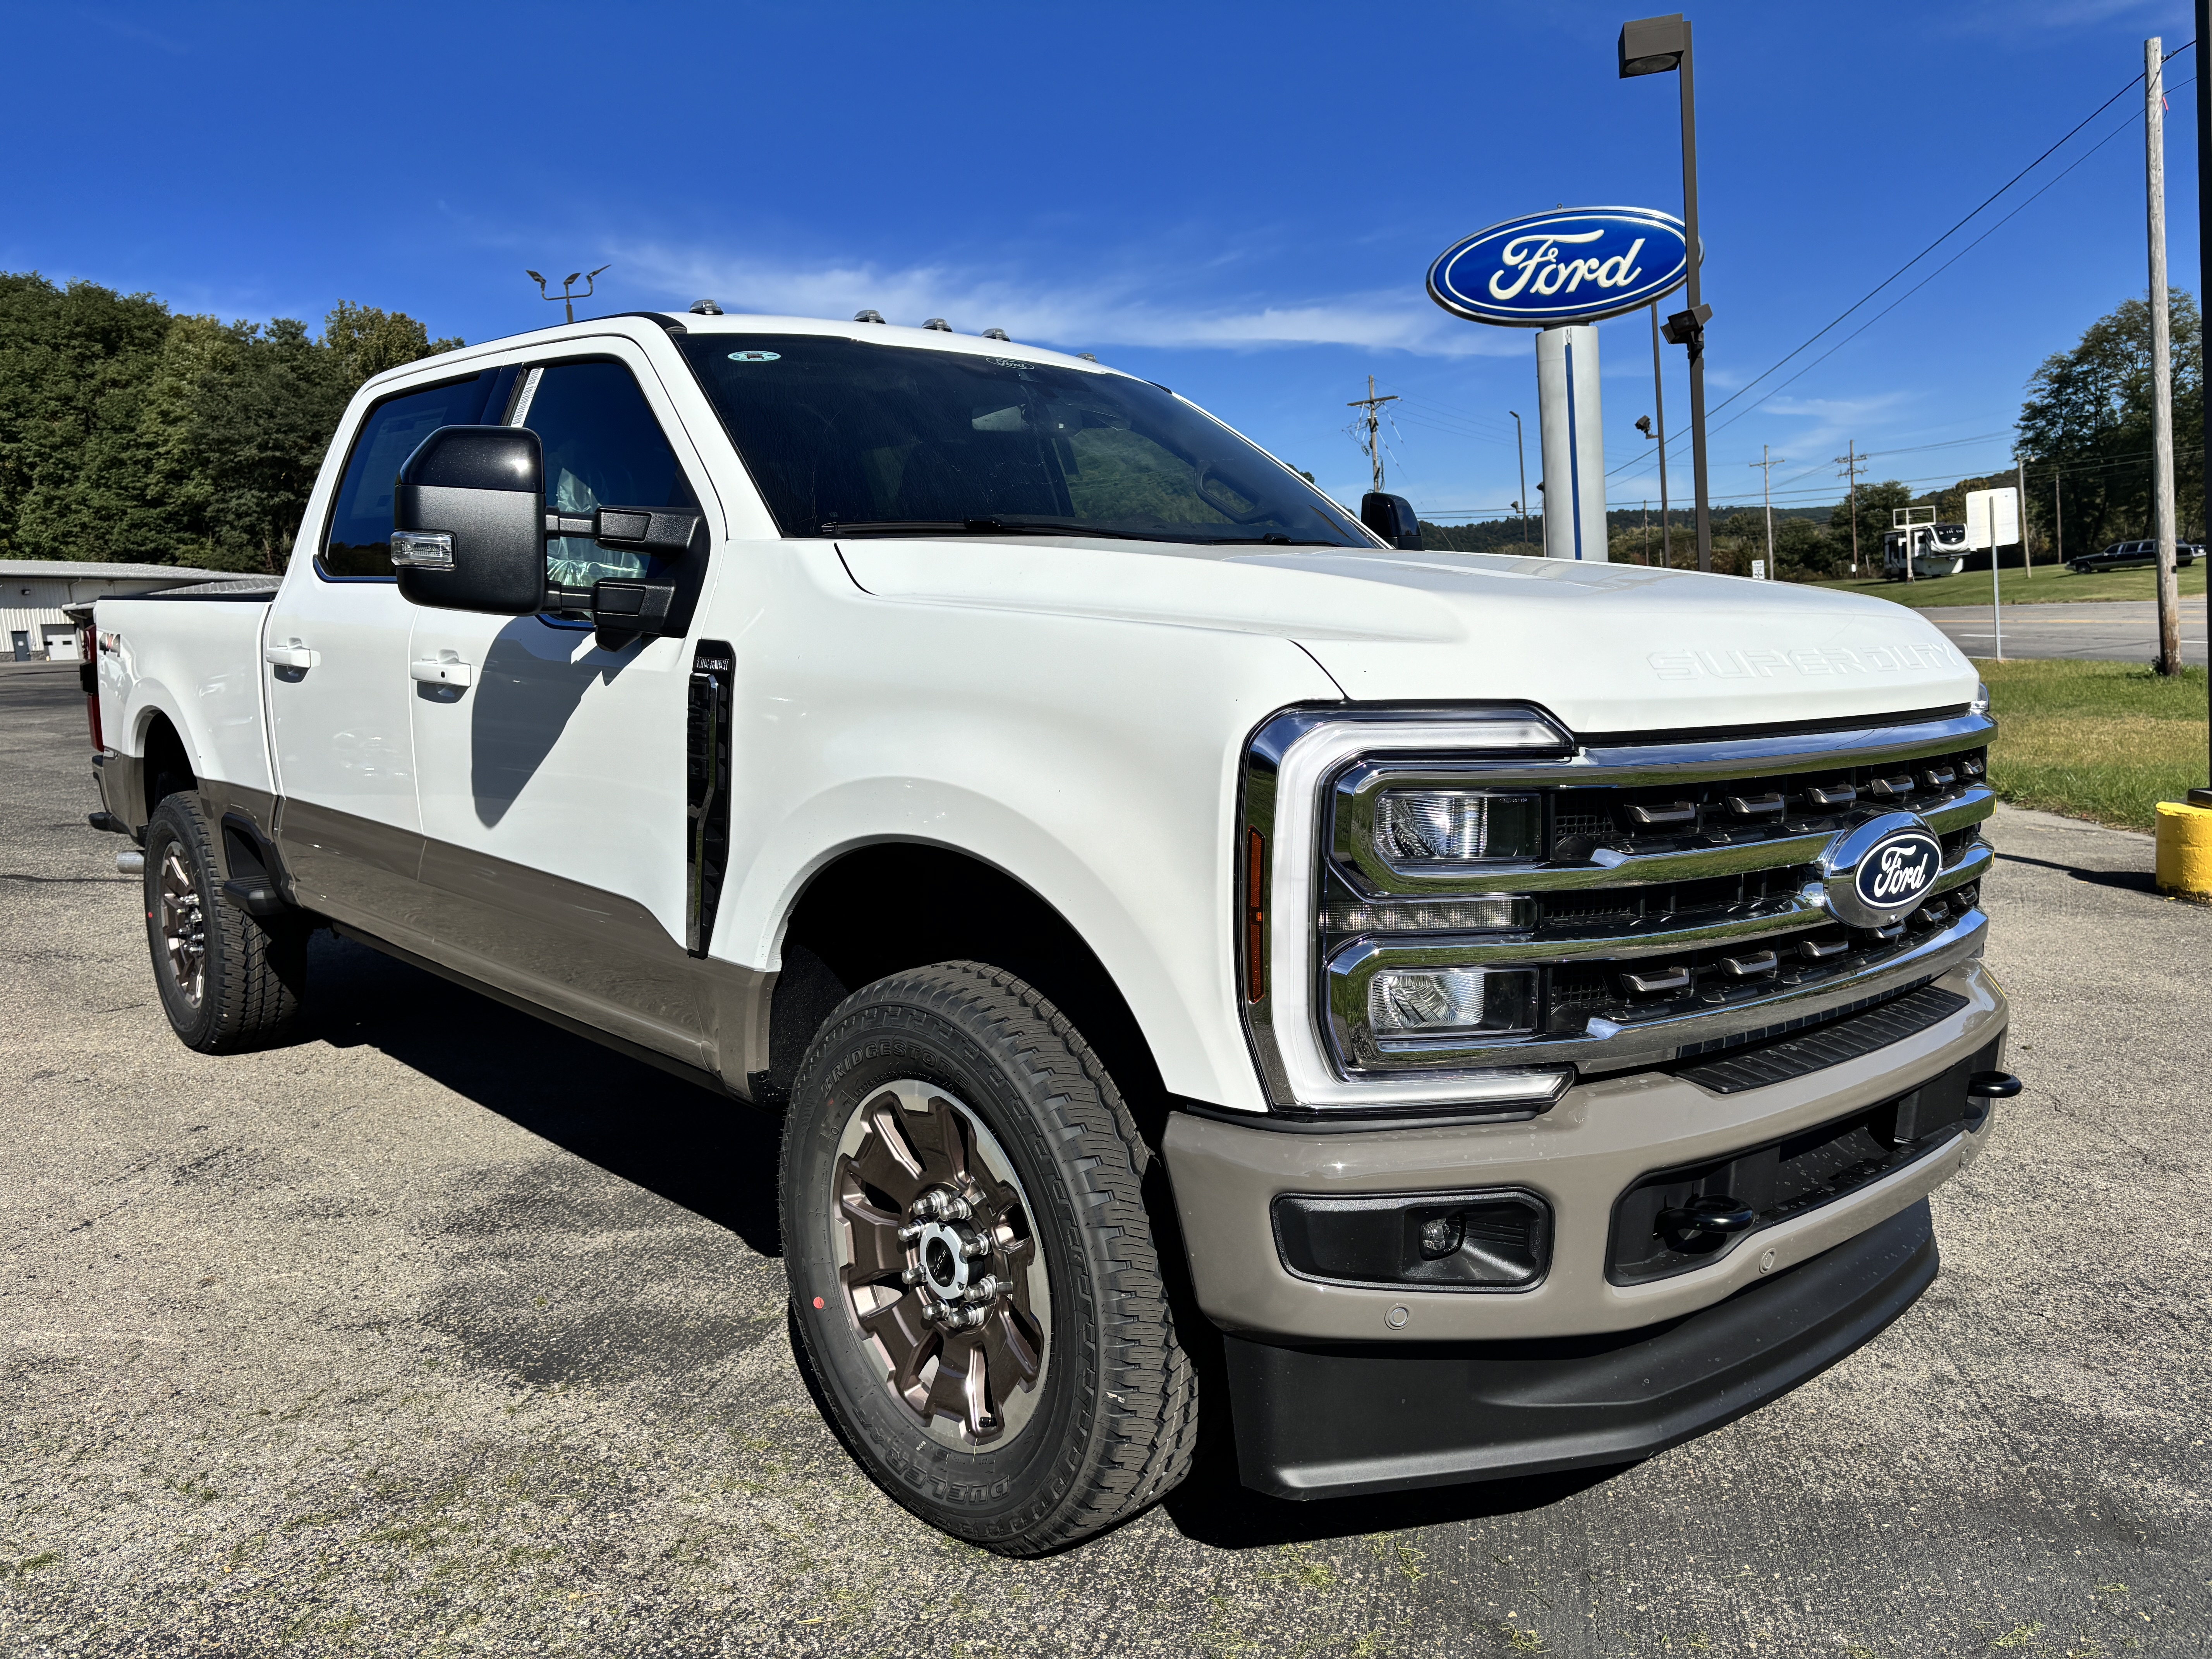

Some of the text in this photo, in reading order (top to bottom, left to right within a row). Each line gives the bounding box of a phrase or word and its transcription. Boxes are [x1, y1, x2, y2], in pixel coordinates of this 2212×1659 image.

[1489, 229, 1645, 300] Ford
[996, 359, 1027, 368] Ford
[1646, 647, 1868, 681] SUPER
[1874, 845, 1929, 898] Ford
[820, 1038, 970, 1101] BRIDGESTONE
[885, 1448, 1011, 1505] DUELER
